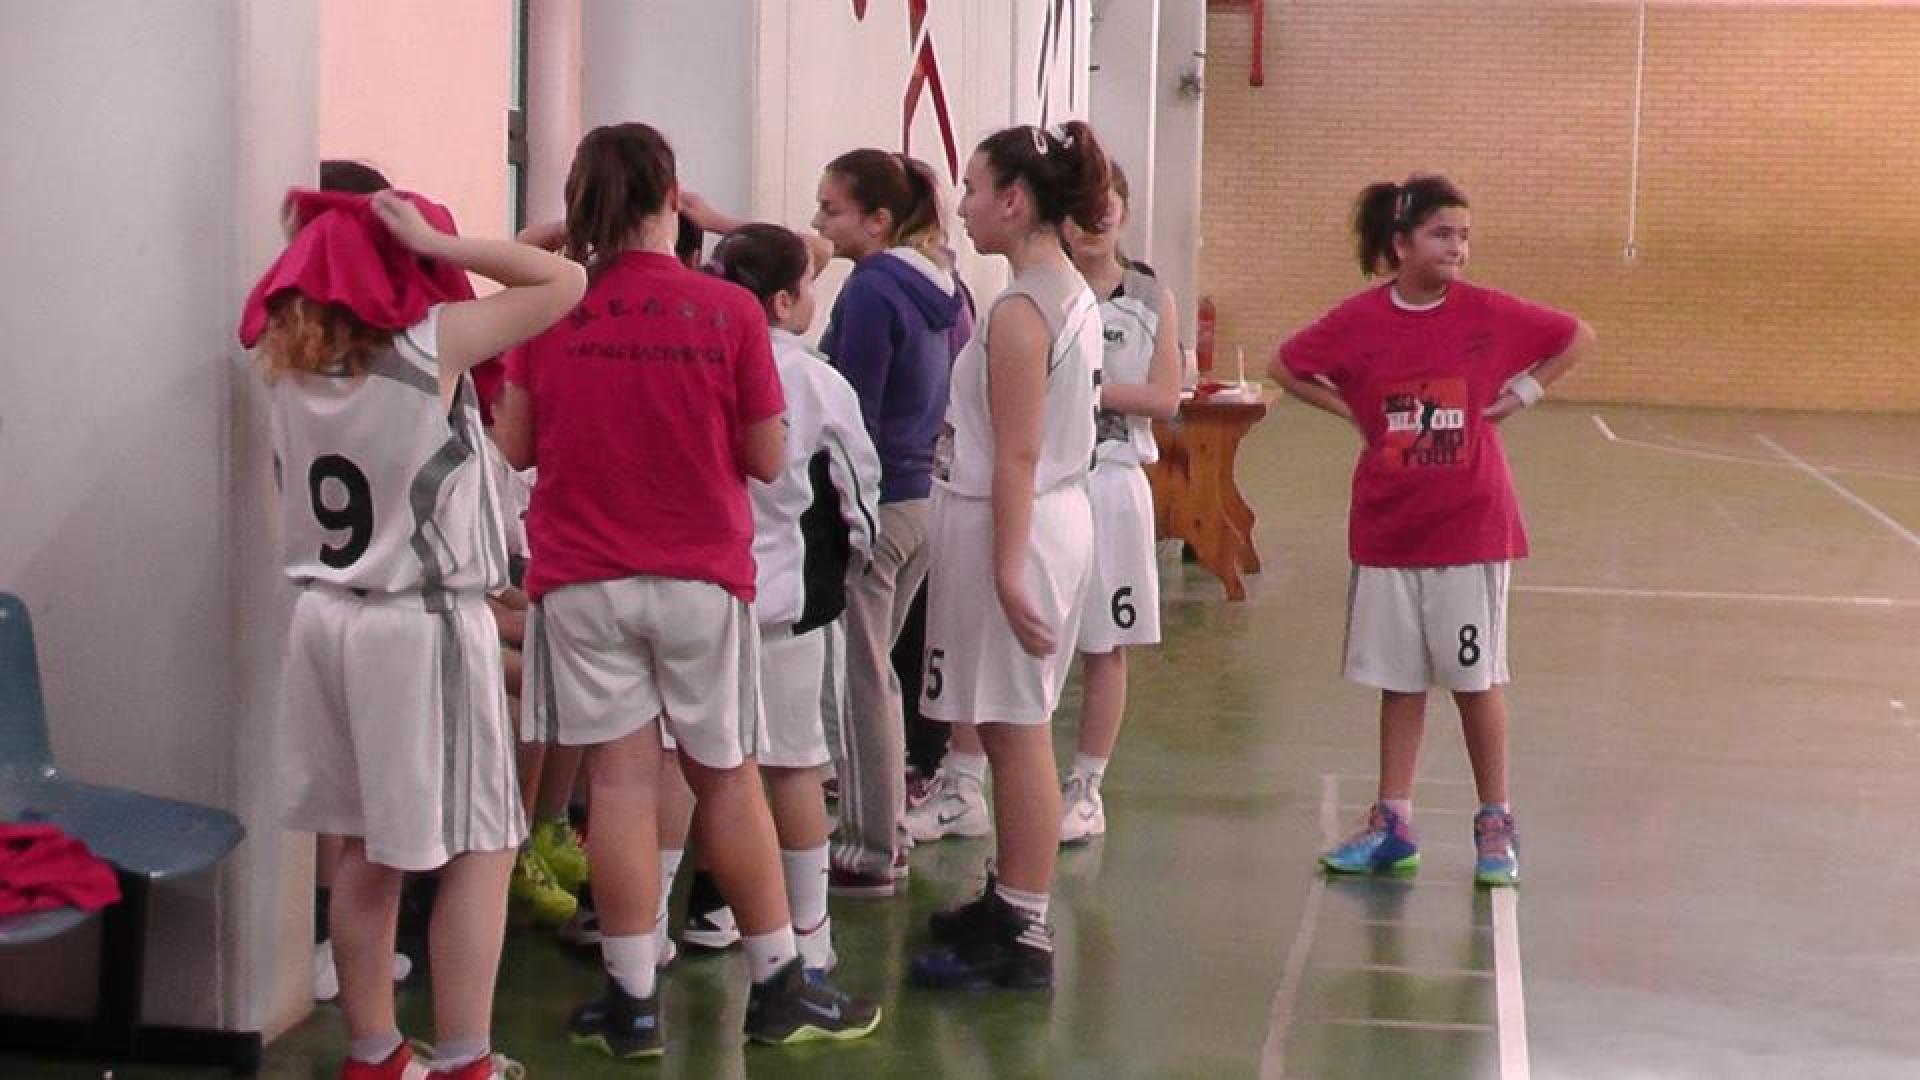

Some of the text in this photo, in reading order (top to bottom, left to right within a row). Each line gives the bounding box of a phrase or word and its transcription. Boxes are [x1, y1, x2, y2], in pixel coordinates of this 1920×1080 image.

[308, 453, 373, 569] 9
[1111, 586, 1137, 630] 6
[1457, 624, 1481, 668] 8
